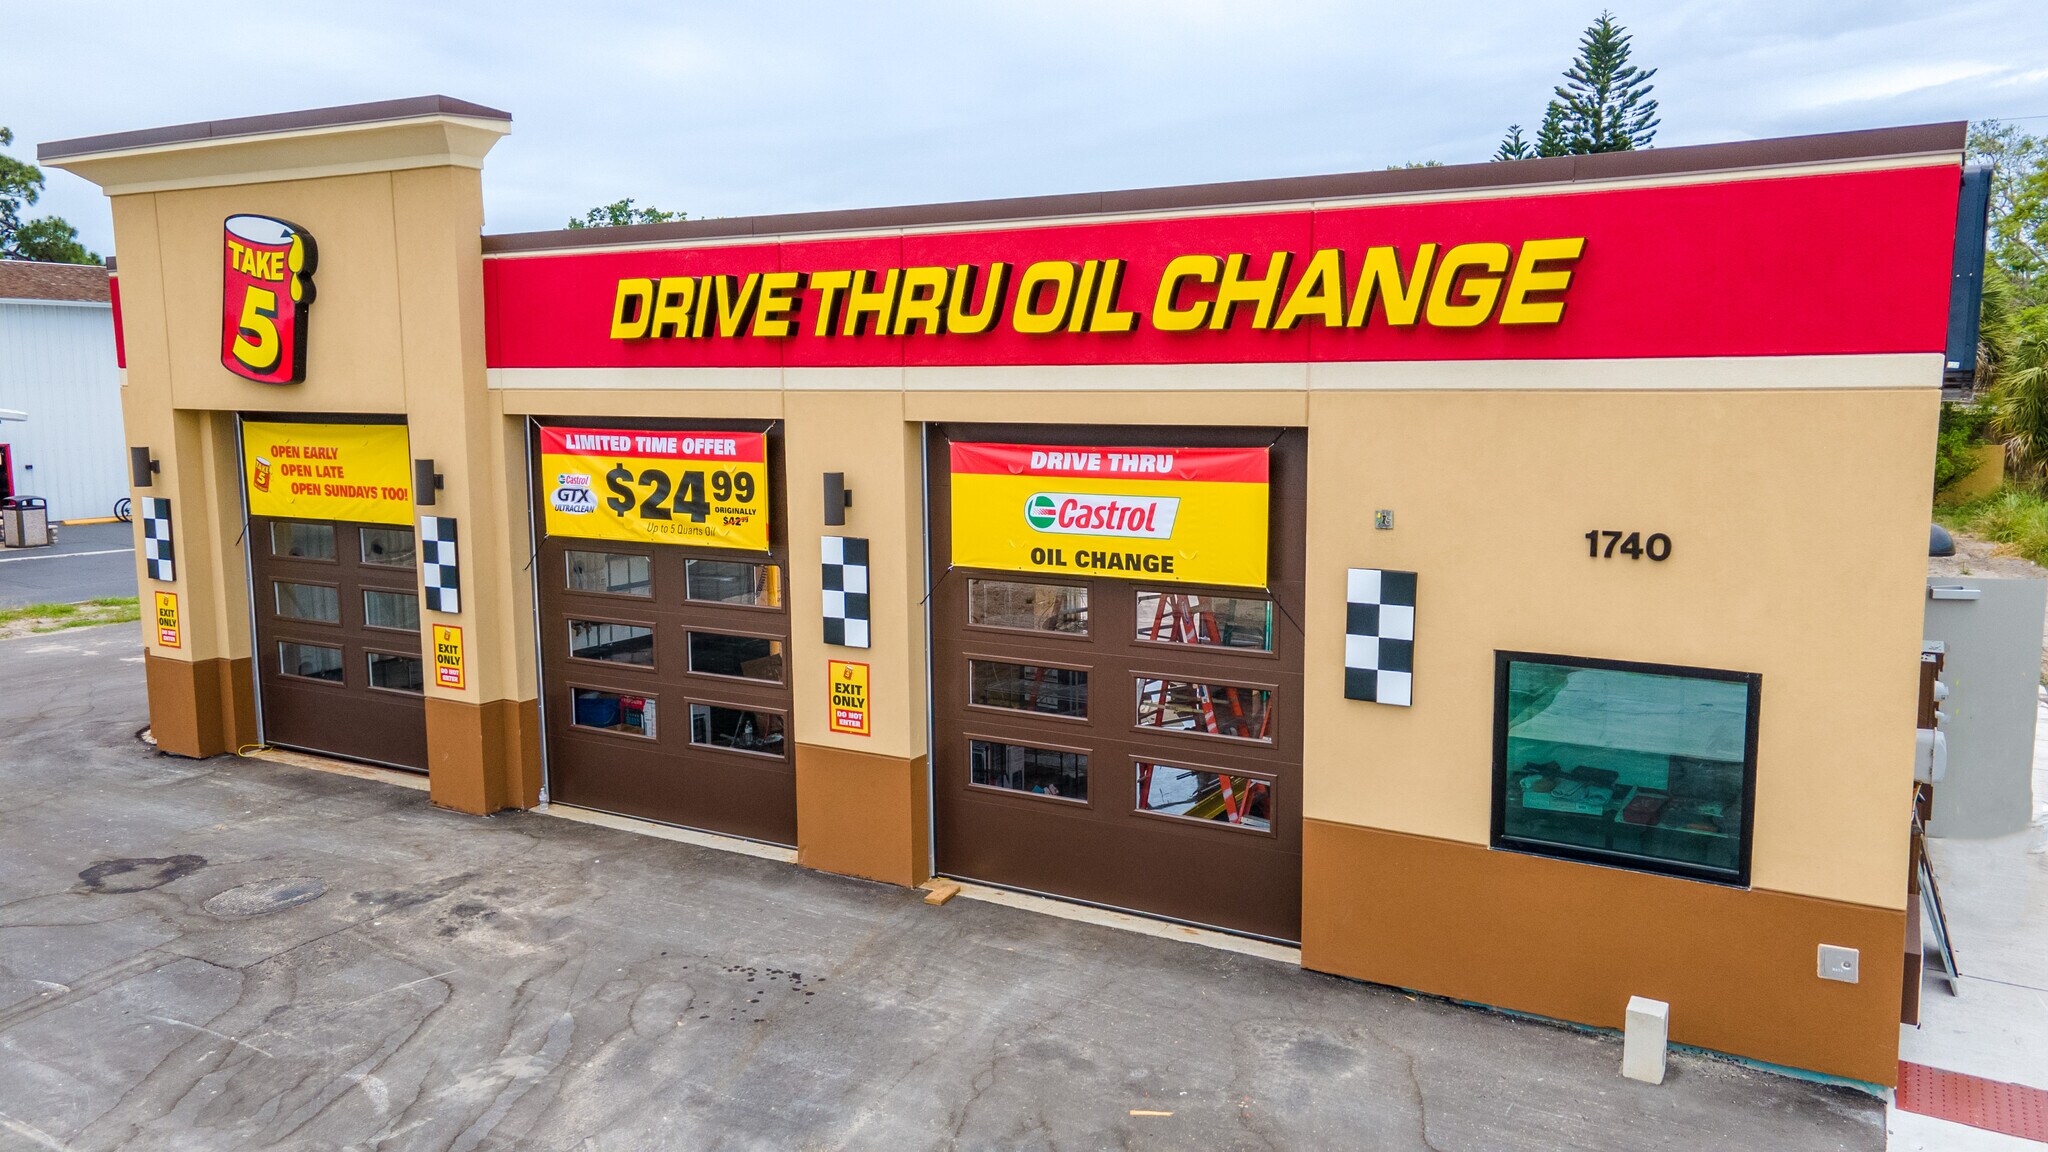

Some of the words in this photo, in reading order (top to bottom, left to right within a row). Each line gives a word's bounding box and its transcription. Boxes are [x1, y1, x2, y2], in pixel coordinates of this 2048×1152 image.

[227, 240, 285, 281] TAKE
[609, 271, 801, 340] DRIVE
[809, 262, 1008, 338] THRU
[1011, 258, 1137, 334] OIL
[1151, 237, 1586, 332] CHANGE
[232, 285, 280, 372] 5
[270, 445, 300, 459] OPEN
[303, 446, 338, 460] EARLY
[565, 434, 632, 452] LIMITED
[635, 436, 678, 454] TIME
[682, 437, 737, 456] OFFER
[1030, 451, 1101, 471] DRIVE
[1107, 453, 1173, 474] THRU
[257, 472, 266, 485] 5
[281, 463, 312, 477] OPEN
[315, 465, 344, 479] LATE
[566, 475, 589, 485] Castrol
[291, 482, 321, 496] OPEN
[324, 484, 377, 499] SUNDAYS
[381, 487, 408, 501] TOO!
[558, 488, 591, 503] GTX
[554, 504, 594, 513] ULTRACLEAN
[714, 506, 756, 515] ORIGINALLY
[1058, 498, 1157, 532] Castrol
[647, 522, 659, 534] Up
[660, 524, 668, 533] to
[670, 524, 675, 534] 5
[677, 524, 703, 535] Quarts
[704, 526, 716, 537] Oil
[1585, 530, 1672, 562] 1740
[1030, 547, 1067, 567] OIL
[1075, 550, 1174, 574] CHANGE
[159, 608, 175, 618] EXIT
[158, 617, 177, 627] ONLY
[438, 643, 459, 655] EXIT
[437, 654, 461, 666] ONLY
[834, 682, 862, 696] EXIT
[832, 695, 865, 709] ONLY
[836, 710, 847, 718] DO
[848, 712, 863, 720] NOT
[838, 718, 861, 728] ENTER
